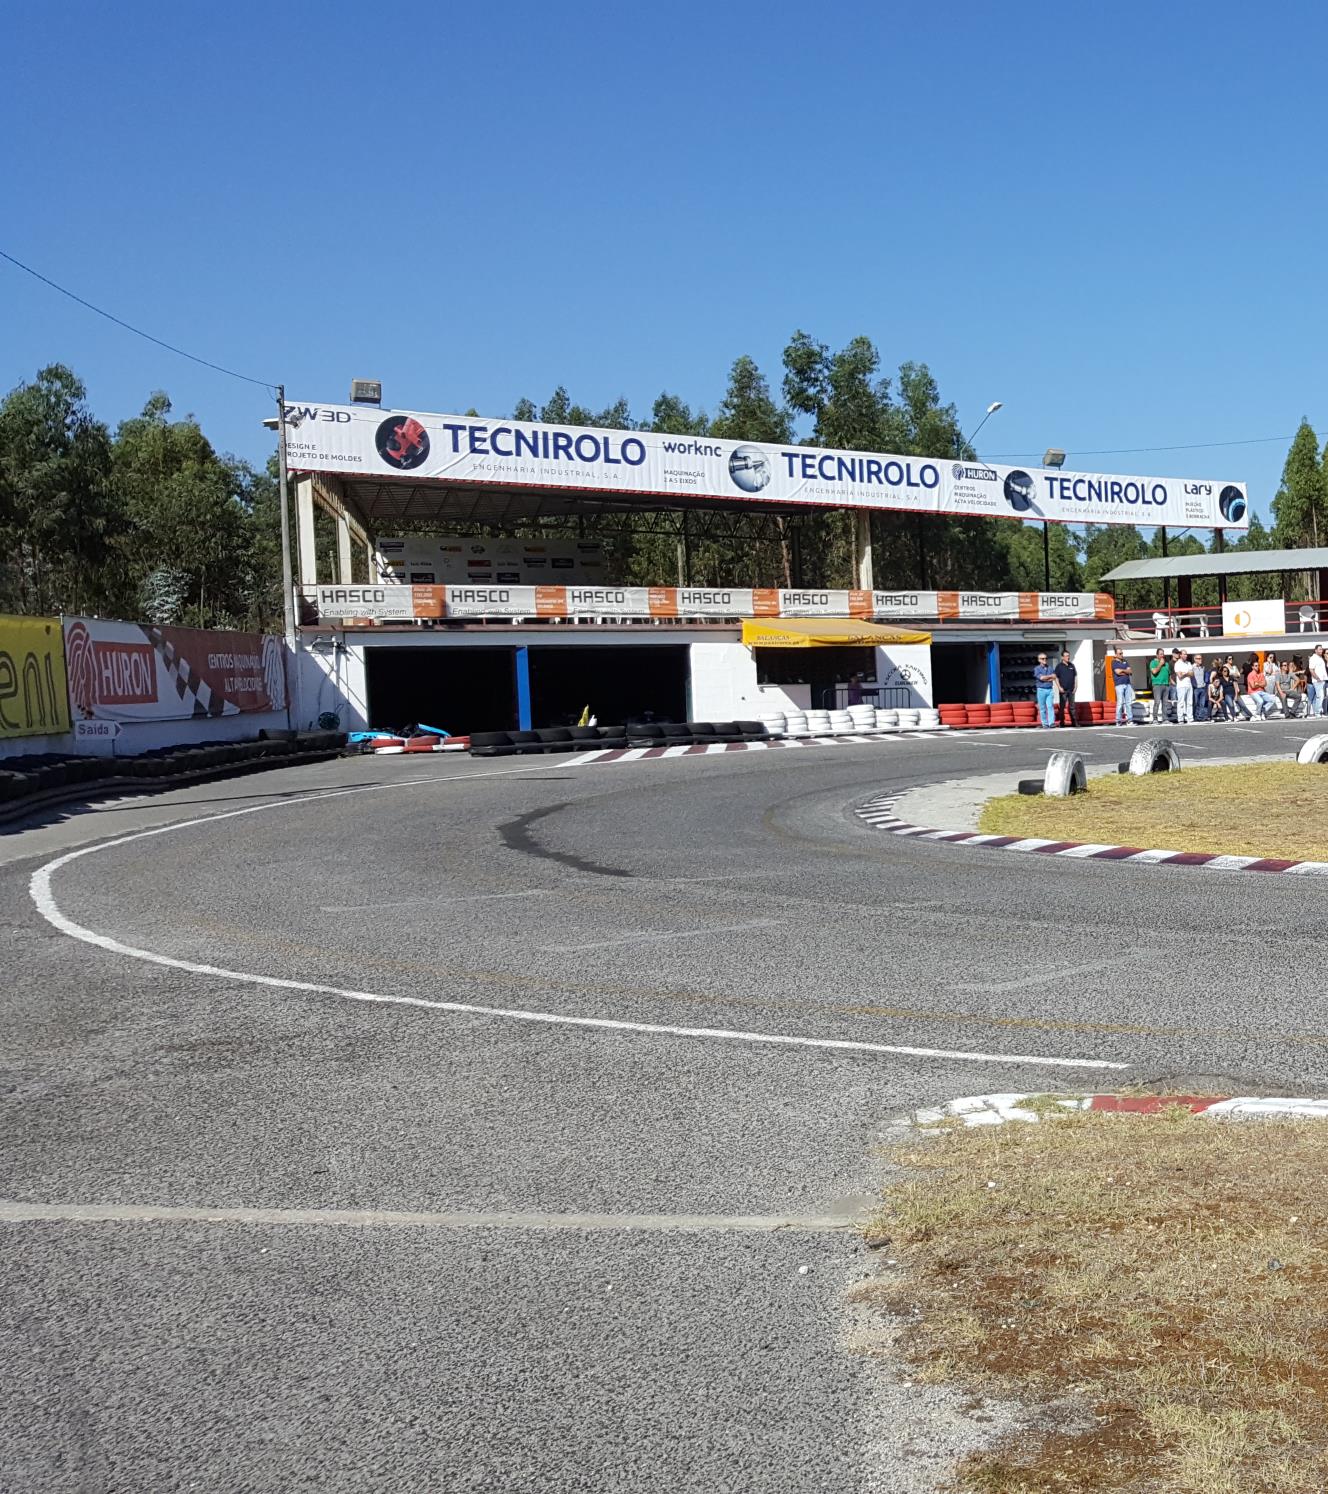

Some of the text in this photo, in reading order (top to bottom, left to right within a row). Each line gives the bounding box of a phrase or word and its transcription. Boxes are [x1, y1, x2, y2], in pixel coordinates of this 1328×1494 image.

[286, 442, 310, 450] ESIGN
[442, 423, 646, 466] TECNIROLO
[662, 440, 722, 457] worknc
[286, 451, 318, 459] ROJETO
[473, 463, 536, 474] ENGENHARIA
[781, 452, 940, 489] TECNIROLO
[967, 469, 995, 480] HURON
[804, 487, 854, 496] ENGENHARIA
[953, 484, 976, 492] CENTROS
[1044, 476, 1168, 505] TECNIROLO
[321, 589, 384, 603] HASCO
[451, 590, 510, 603] HASCO
[571, 591, 625, 604] HASCO
[681, 592, 731, 605] HASCO
[783, 593, 828, 605] HASCO
[875, 595, 919, 606] HASCO
[961, 595, 1001, 607] HASCO
[1041, 596, 1079, 607] HASCO
[323, 608, 407, 617] Enabling with System
[100, 650, 152, 697] HURON
